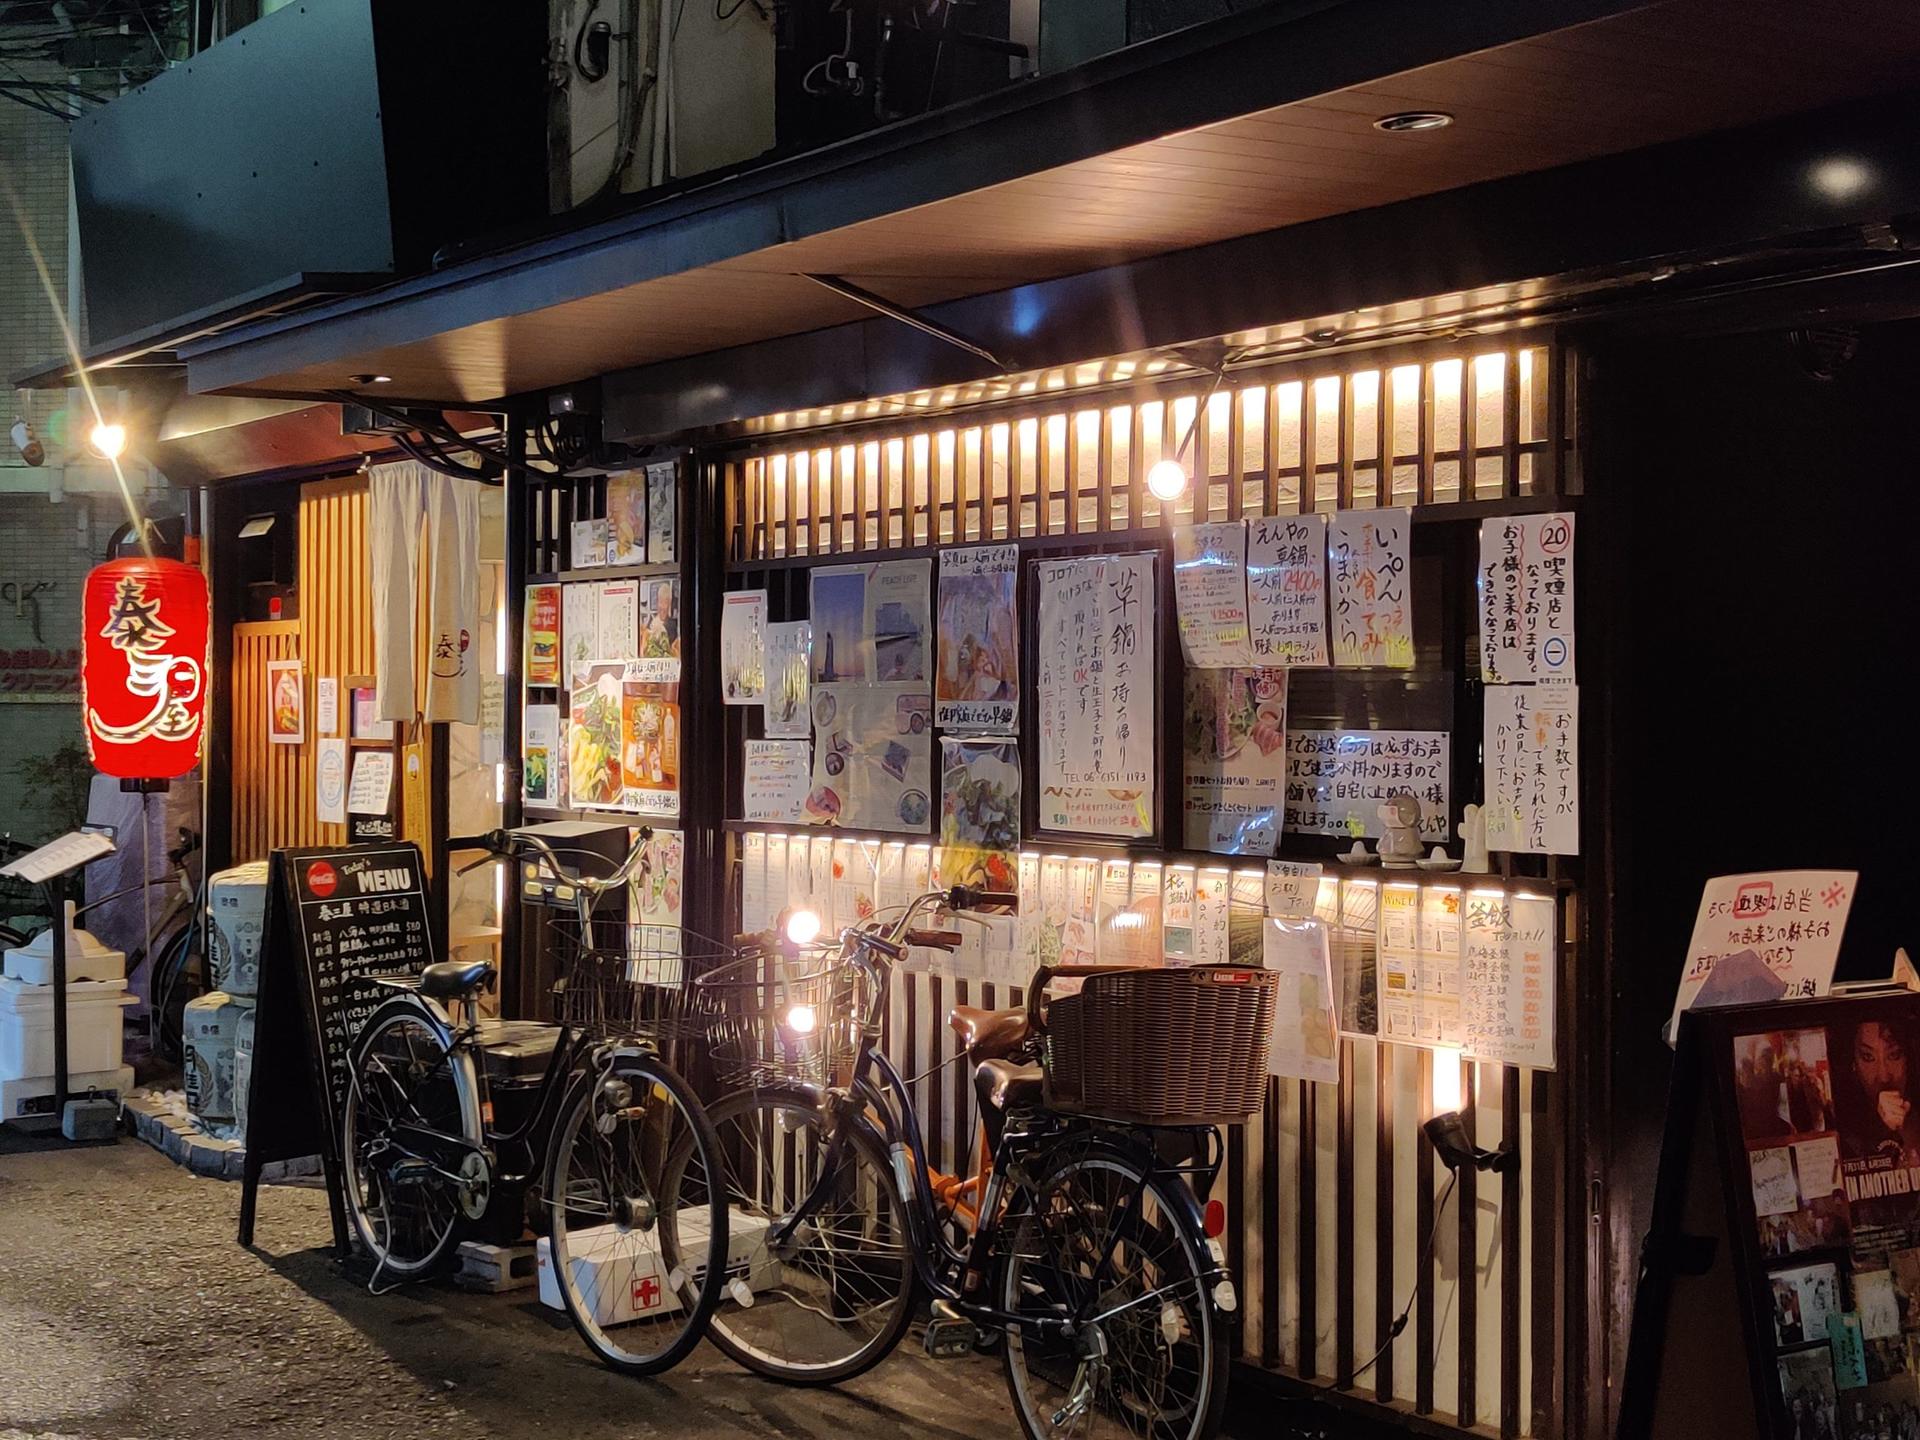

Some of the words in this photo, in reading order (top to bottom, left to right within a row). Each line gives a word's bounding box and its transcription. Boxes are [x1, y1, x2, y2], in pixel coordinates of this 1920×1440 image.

[1256, 521, 1309, 544] えんやの
[1273, 544, 1308, 567] 草鍋
[1376, 527, 1404, 602] いっぺん
[1544, 527, 1566, 546] 20
[1253, 571, 1281, 589] 一人前
[1336, 529, 1360, 649] うまいから
[1502, 525, 1521, 650] お子様のご来店は
[1544, 560, 1567, 629] 喫煙店と
[1484, 564, 1502, 681] できなくなっております。
[1525, 563, 1541, 673] なっております。
[1064, 773, 1081, 783] TEL
[1496, 723, 1511, 805] かけて下さい
[1512, 694, 1531, 820] 従業員にお声を
[1555, 713, 1574, 815] お手数ですが
[340, 858, 371, 876] Today's
[357, 868, 412, 893] MENU
[1859, 1168, 1911, 1200] ANOTHER
